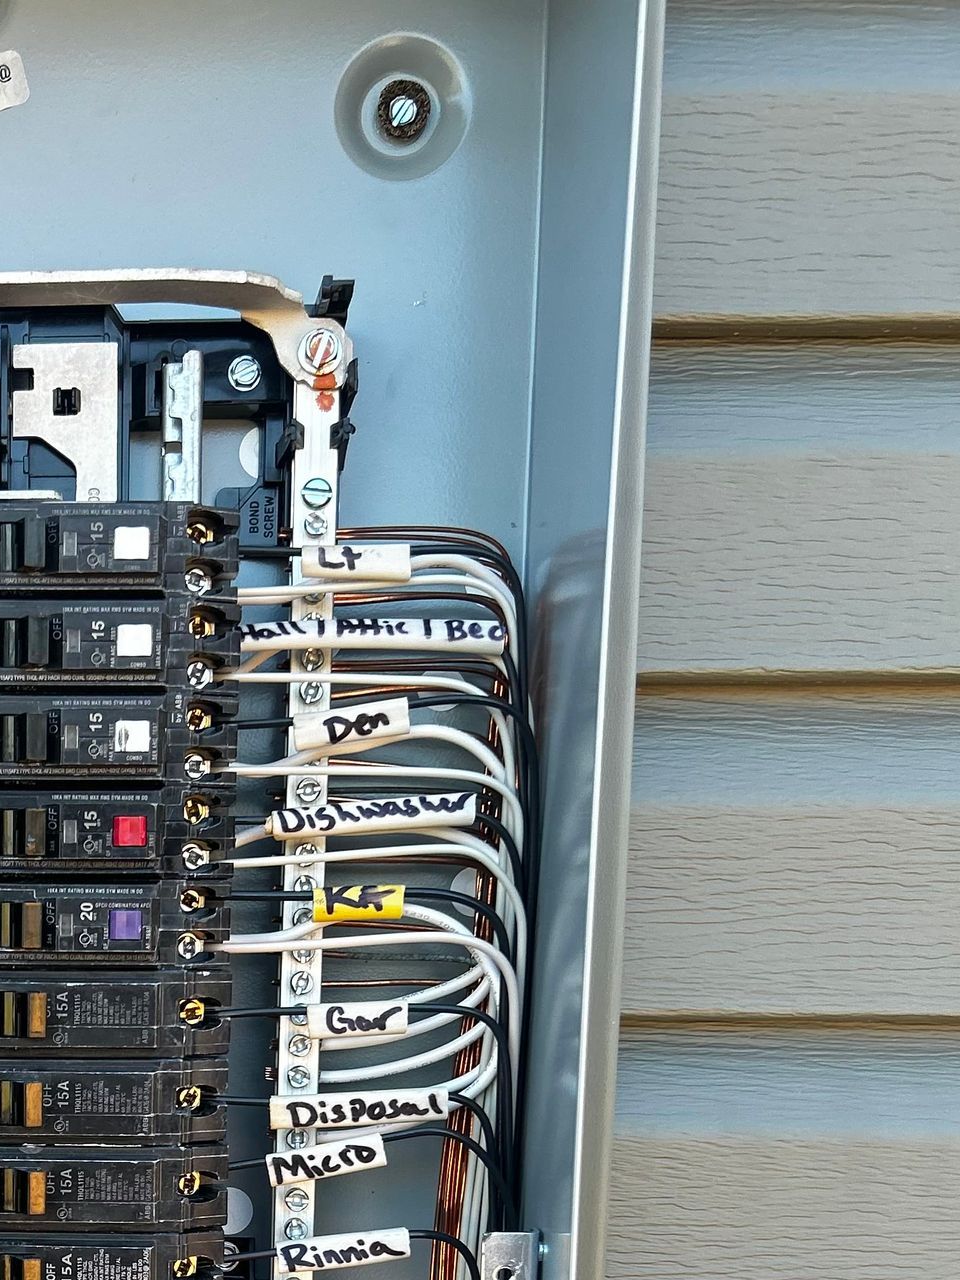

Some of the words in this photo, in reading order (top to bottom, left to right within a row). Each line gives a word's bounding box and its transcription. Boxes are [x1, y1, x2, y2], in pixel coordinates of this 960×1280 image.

[249, 500, 259, 533] BOND
[264, 496, 274, 538] SCREW
[48, 521, 57, 543] OFF
[90, 522, 104, 539] 15
[53, 618, 63, 640] OFF
[91, 621, 106, 640] 15
[336, 618, 409, 637] Attic
[49, 712, 59, 734] OFF
[89, 712, 103, 732] 15
[175, 711, 182, 723] by
[323, 712, 390, 744] Den
[48, 808, 57, 829] OFF
[84, 811, 97, 829] 15
[277, 792, 474, 833] Dishwasher
[46, 902, 55, 924] OFF
[80, 902, 93, 921] 20
[56, 992, 68, 1020] 15A
[326, 1006, 402, 1034] Gar
[58, 1081, 70, 1108] 15A
[286, 1094, 443, 1127] Disposal
[272, 1144, 376, 1184] Micro
[60, 1169, 72, 1195] 15A
[281, 1239, 406, 1271] Rinnia
[46, 1263, 56, 1280] OFF
